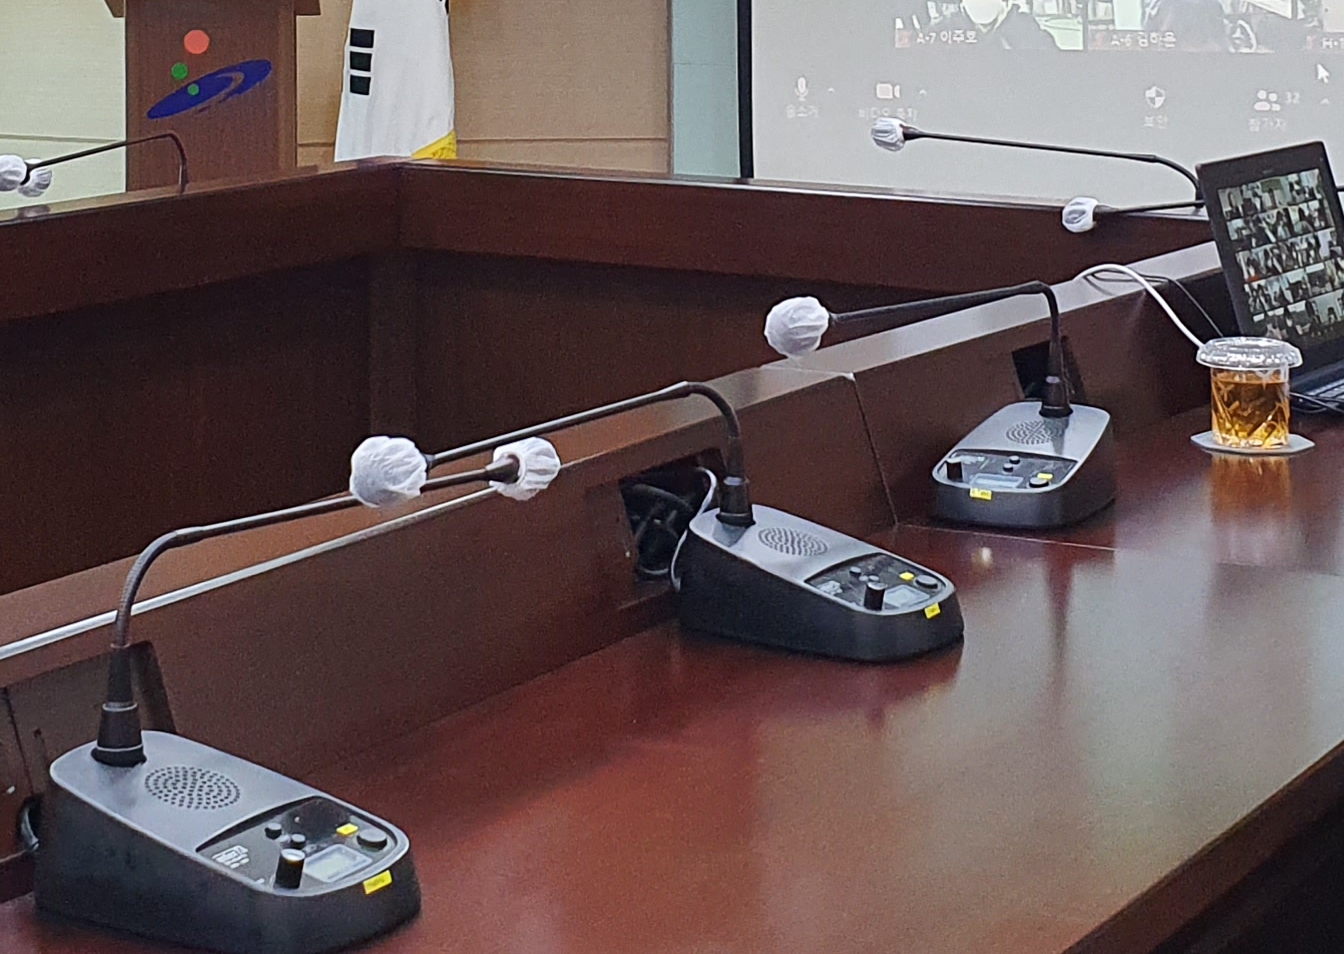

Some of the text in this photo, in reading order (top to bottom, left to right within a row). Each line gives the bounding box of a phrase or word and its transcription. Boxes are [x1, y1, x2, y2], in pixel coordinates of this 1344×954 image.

[915, 29, 978, 45] A-7 이주호
[1109, 34, 1133, 47] A-6
